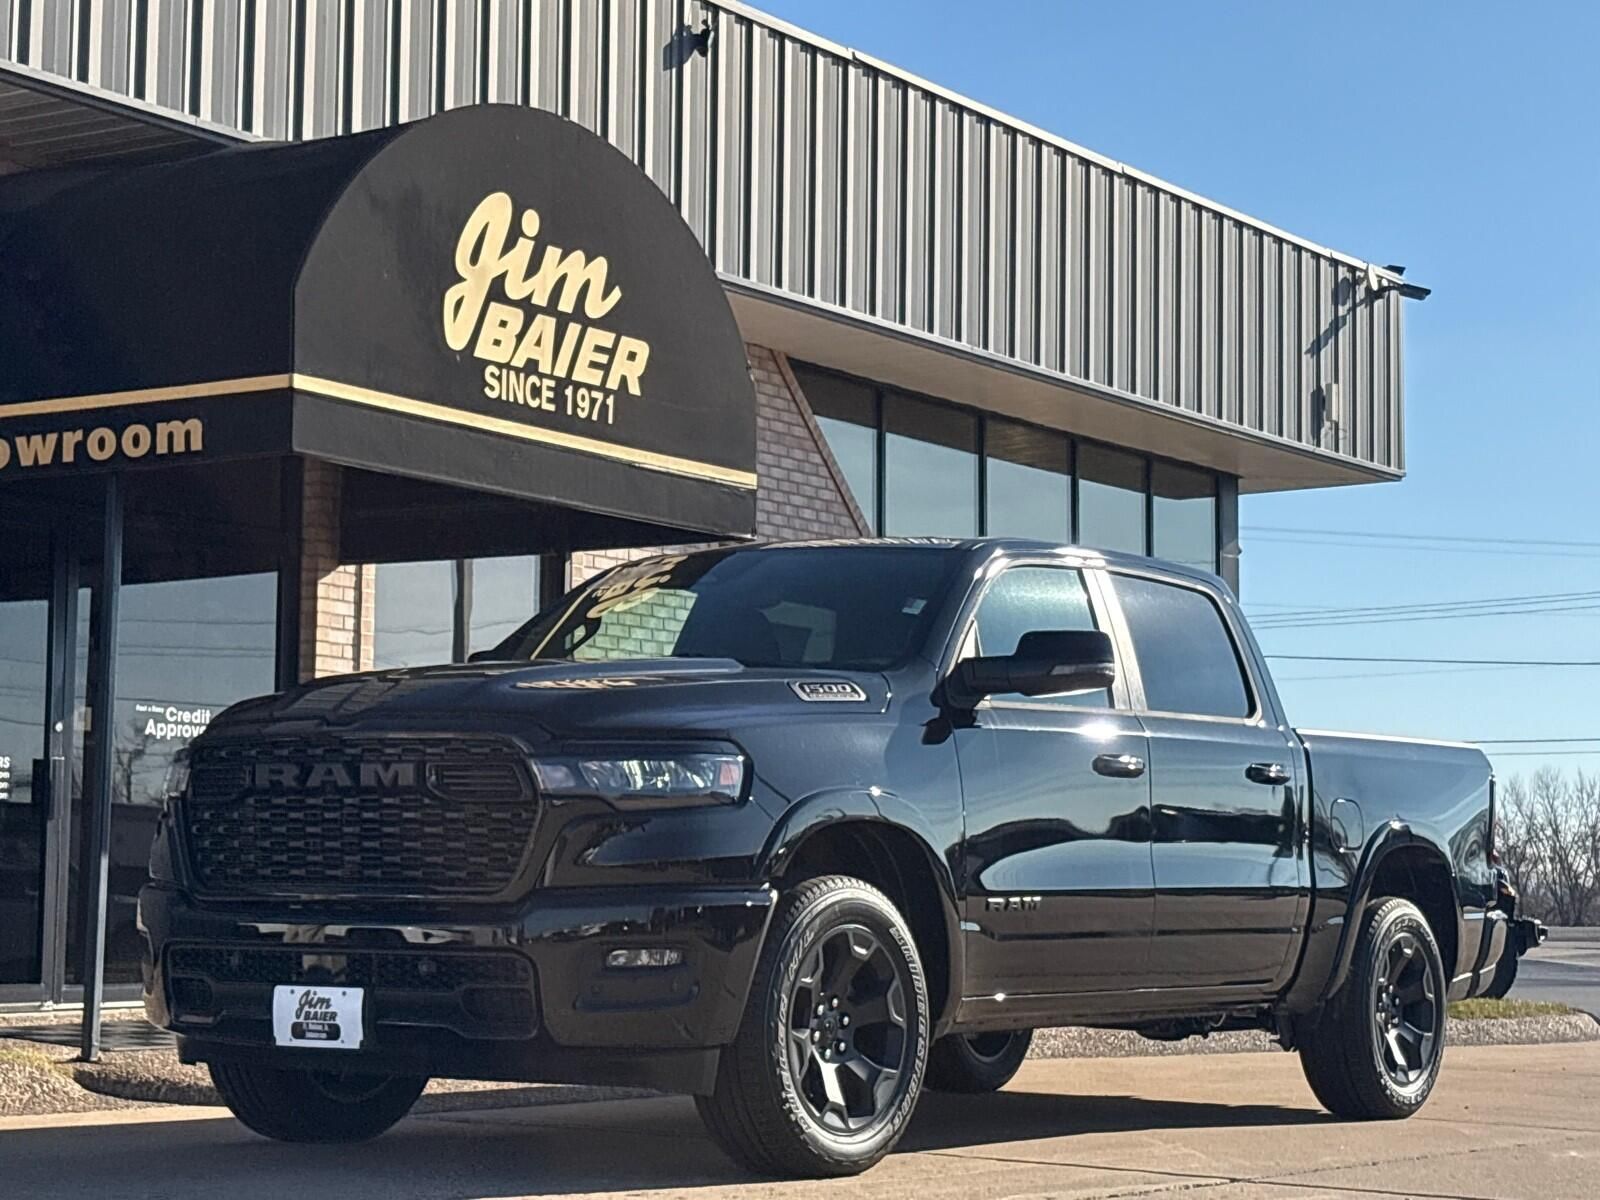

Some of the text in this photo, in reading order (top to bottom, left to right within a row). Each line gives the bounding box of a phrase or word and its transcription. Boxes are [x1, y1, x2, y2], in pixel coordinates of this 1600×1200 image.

[443, 192, 622, 351] Jim
[473, 301, 650, 397] BAIER
[484, 365, 615, 425] SINCE 1971
[803, 683, 851, 693] 1500
[166, 706, 211, 724] Credit
[255, 762, 417, 787] RAM
[295, 989, 332, 1021] Jim
[303, 1010, 338, 1022] BAIER
